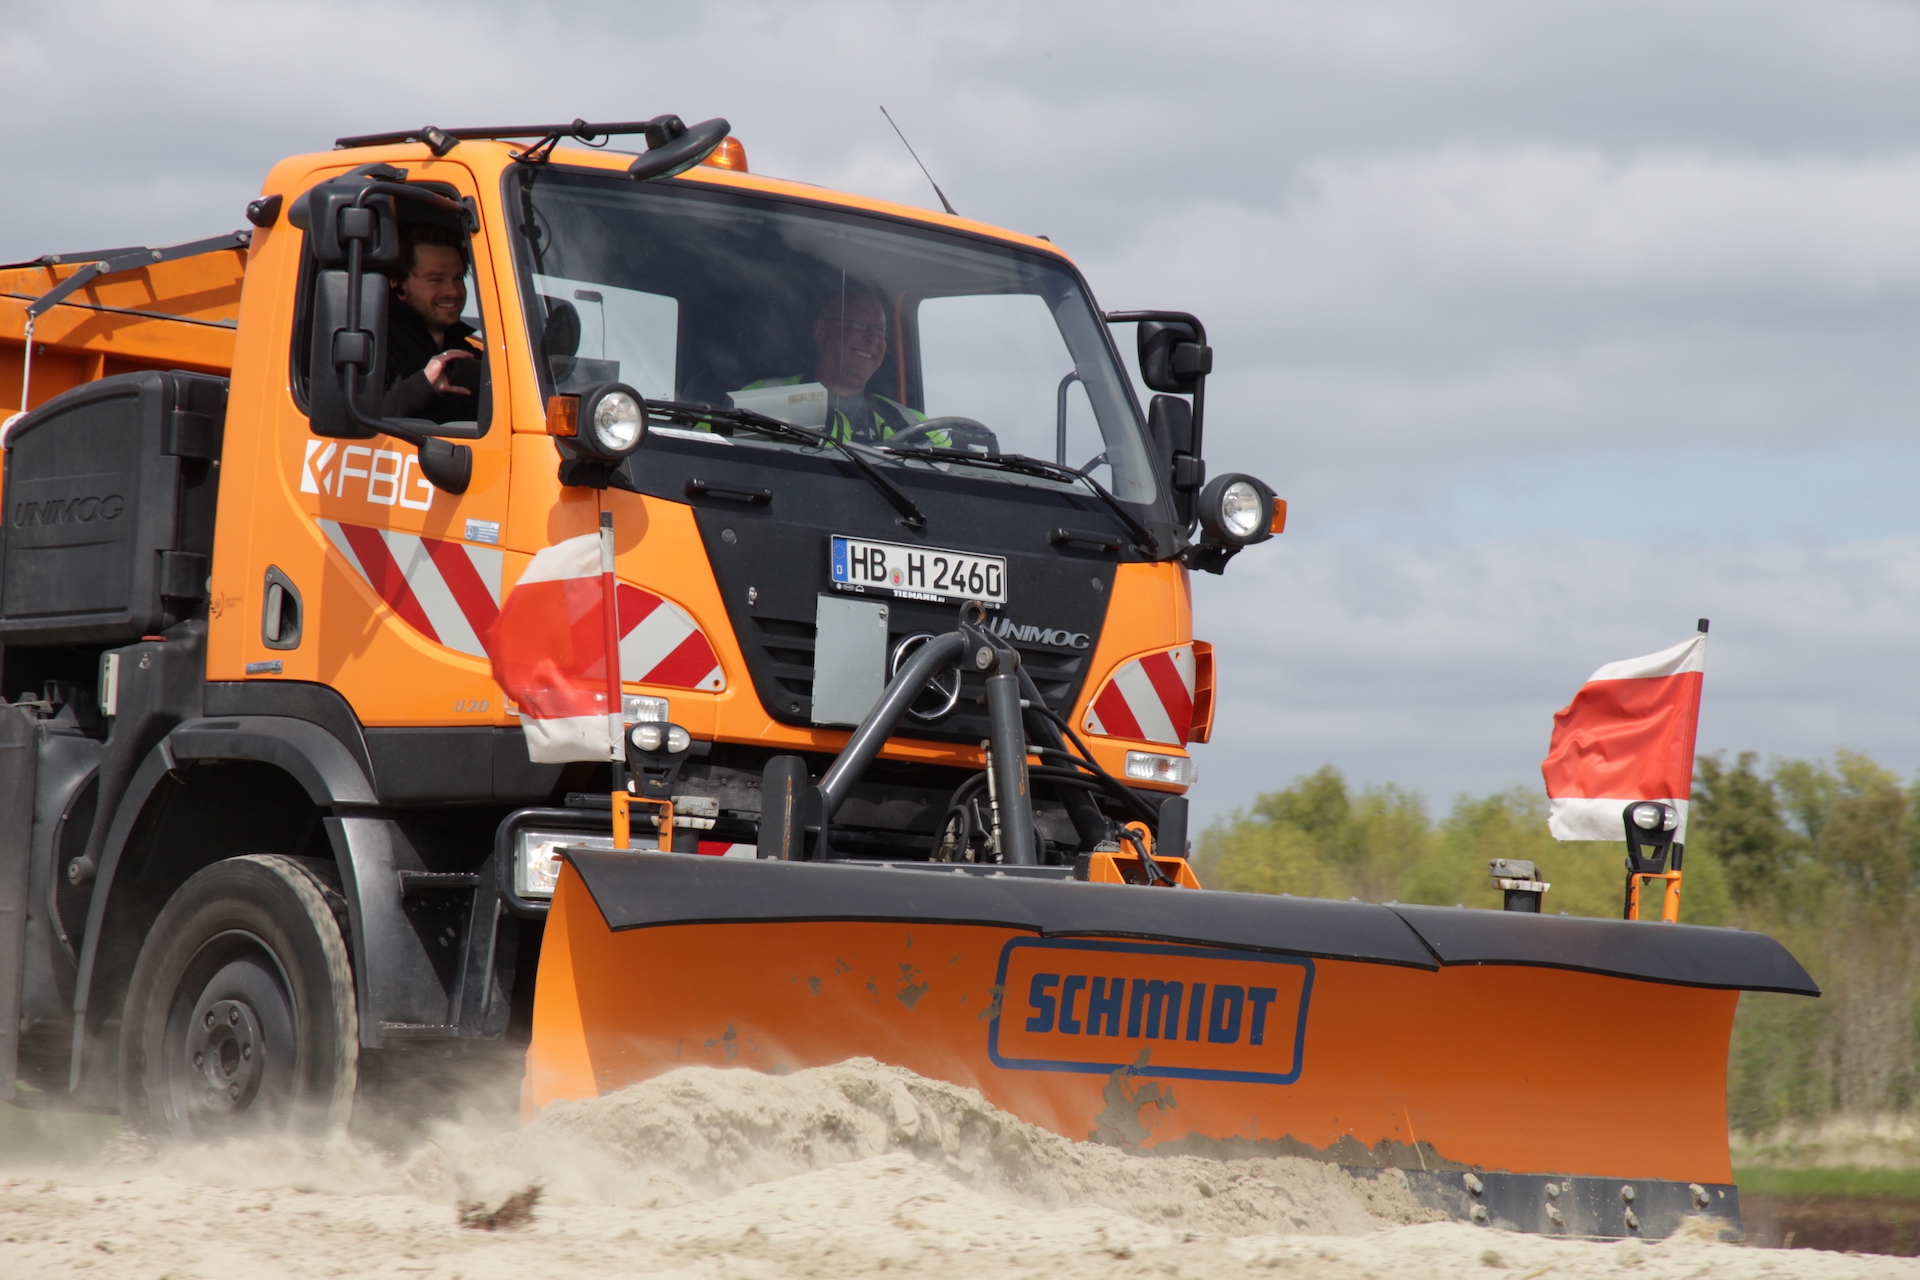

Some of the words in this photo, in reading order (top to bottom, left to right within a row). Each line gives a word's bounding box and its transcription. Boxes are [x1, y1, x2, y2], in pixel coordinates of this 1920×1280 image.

[13, 494, 125, 529] UNIMOG
[851, 546, 887, 582] HB
[1025, 973, 1278, 1046] SCHMIDT
